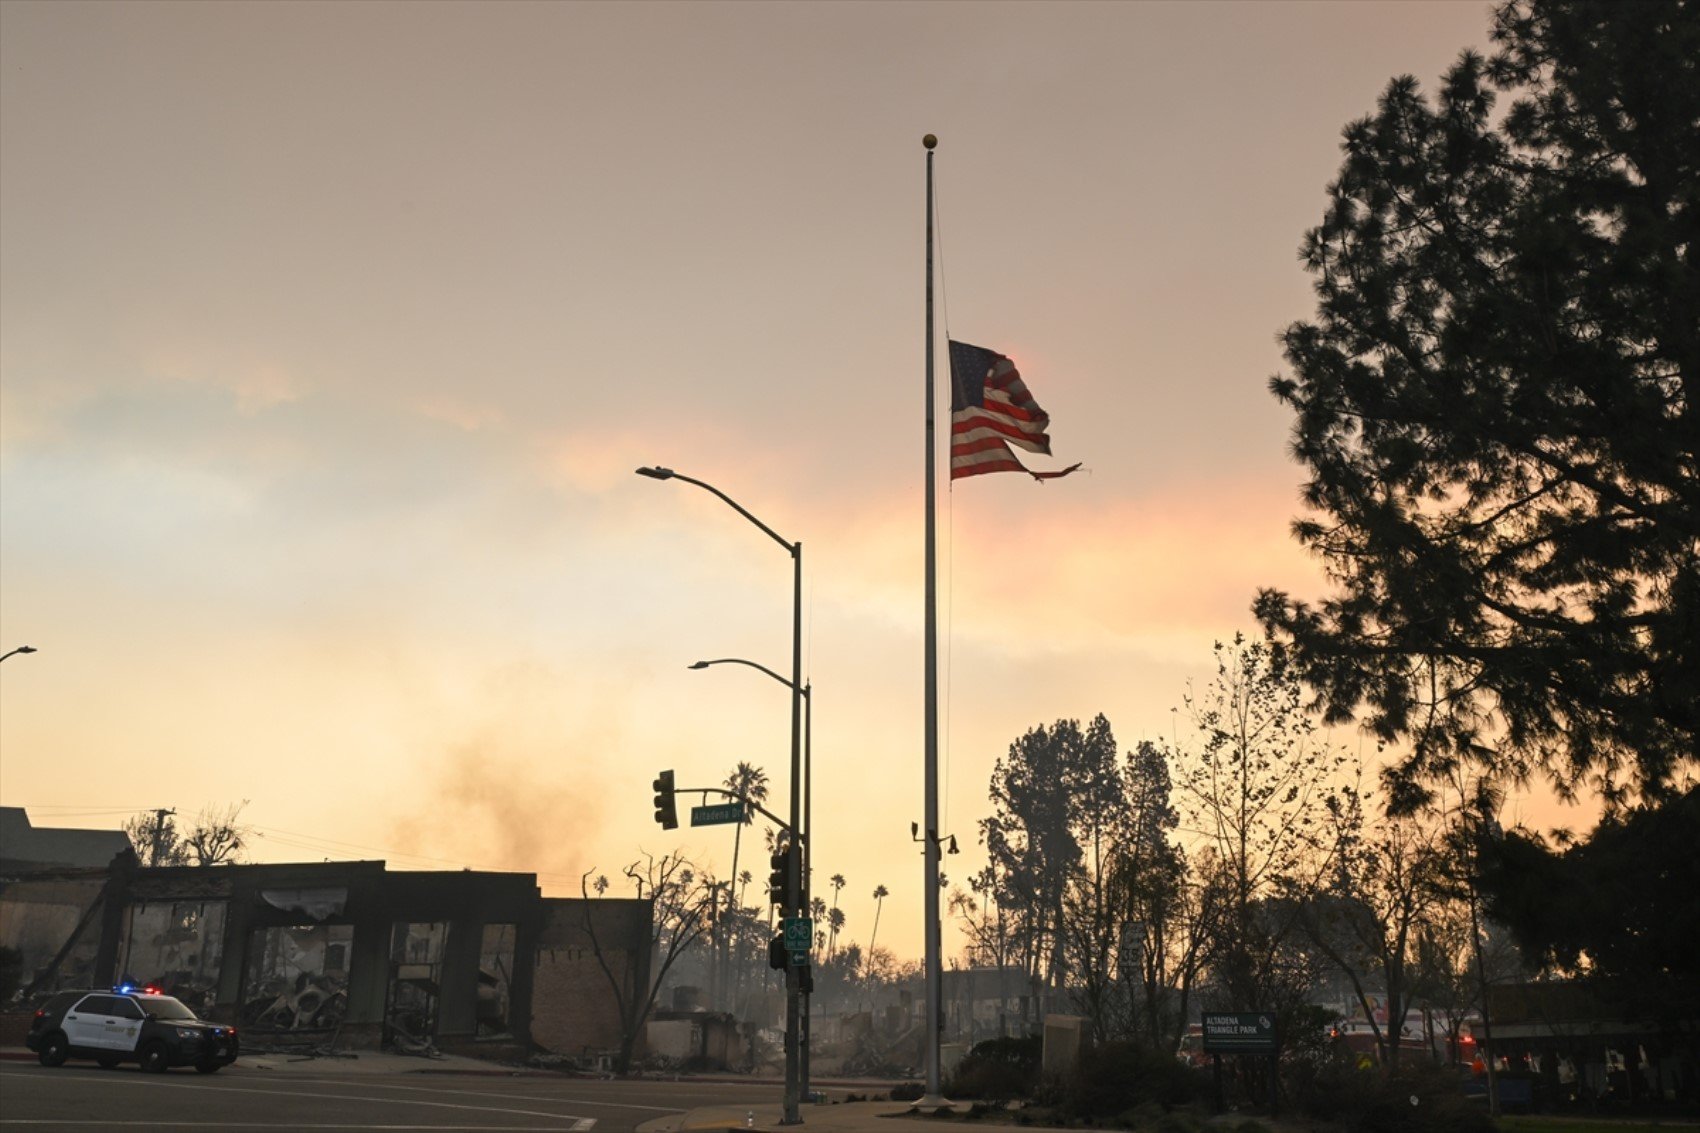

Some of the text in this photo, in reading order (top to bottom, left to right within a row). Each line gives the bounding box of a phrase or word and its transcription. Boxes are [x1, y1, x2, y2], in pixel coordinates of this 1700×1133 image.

[1206, 1017, 1239, 1025] ALTADENA
[1207, 1026, 1257, 1034] TRIANGLE PARK
